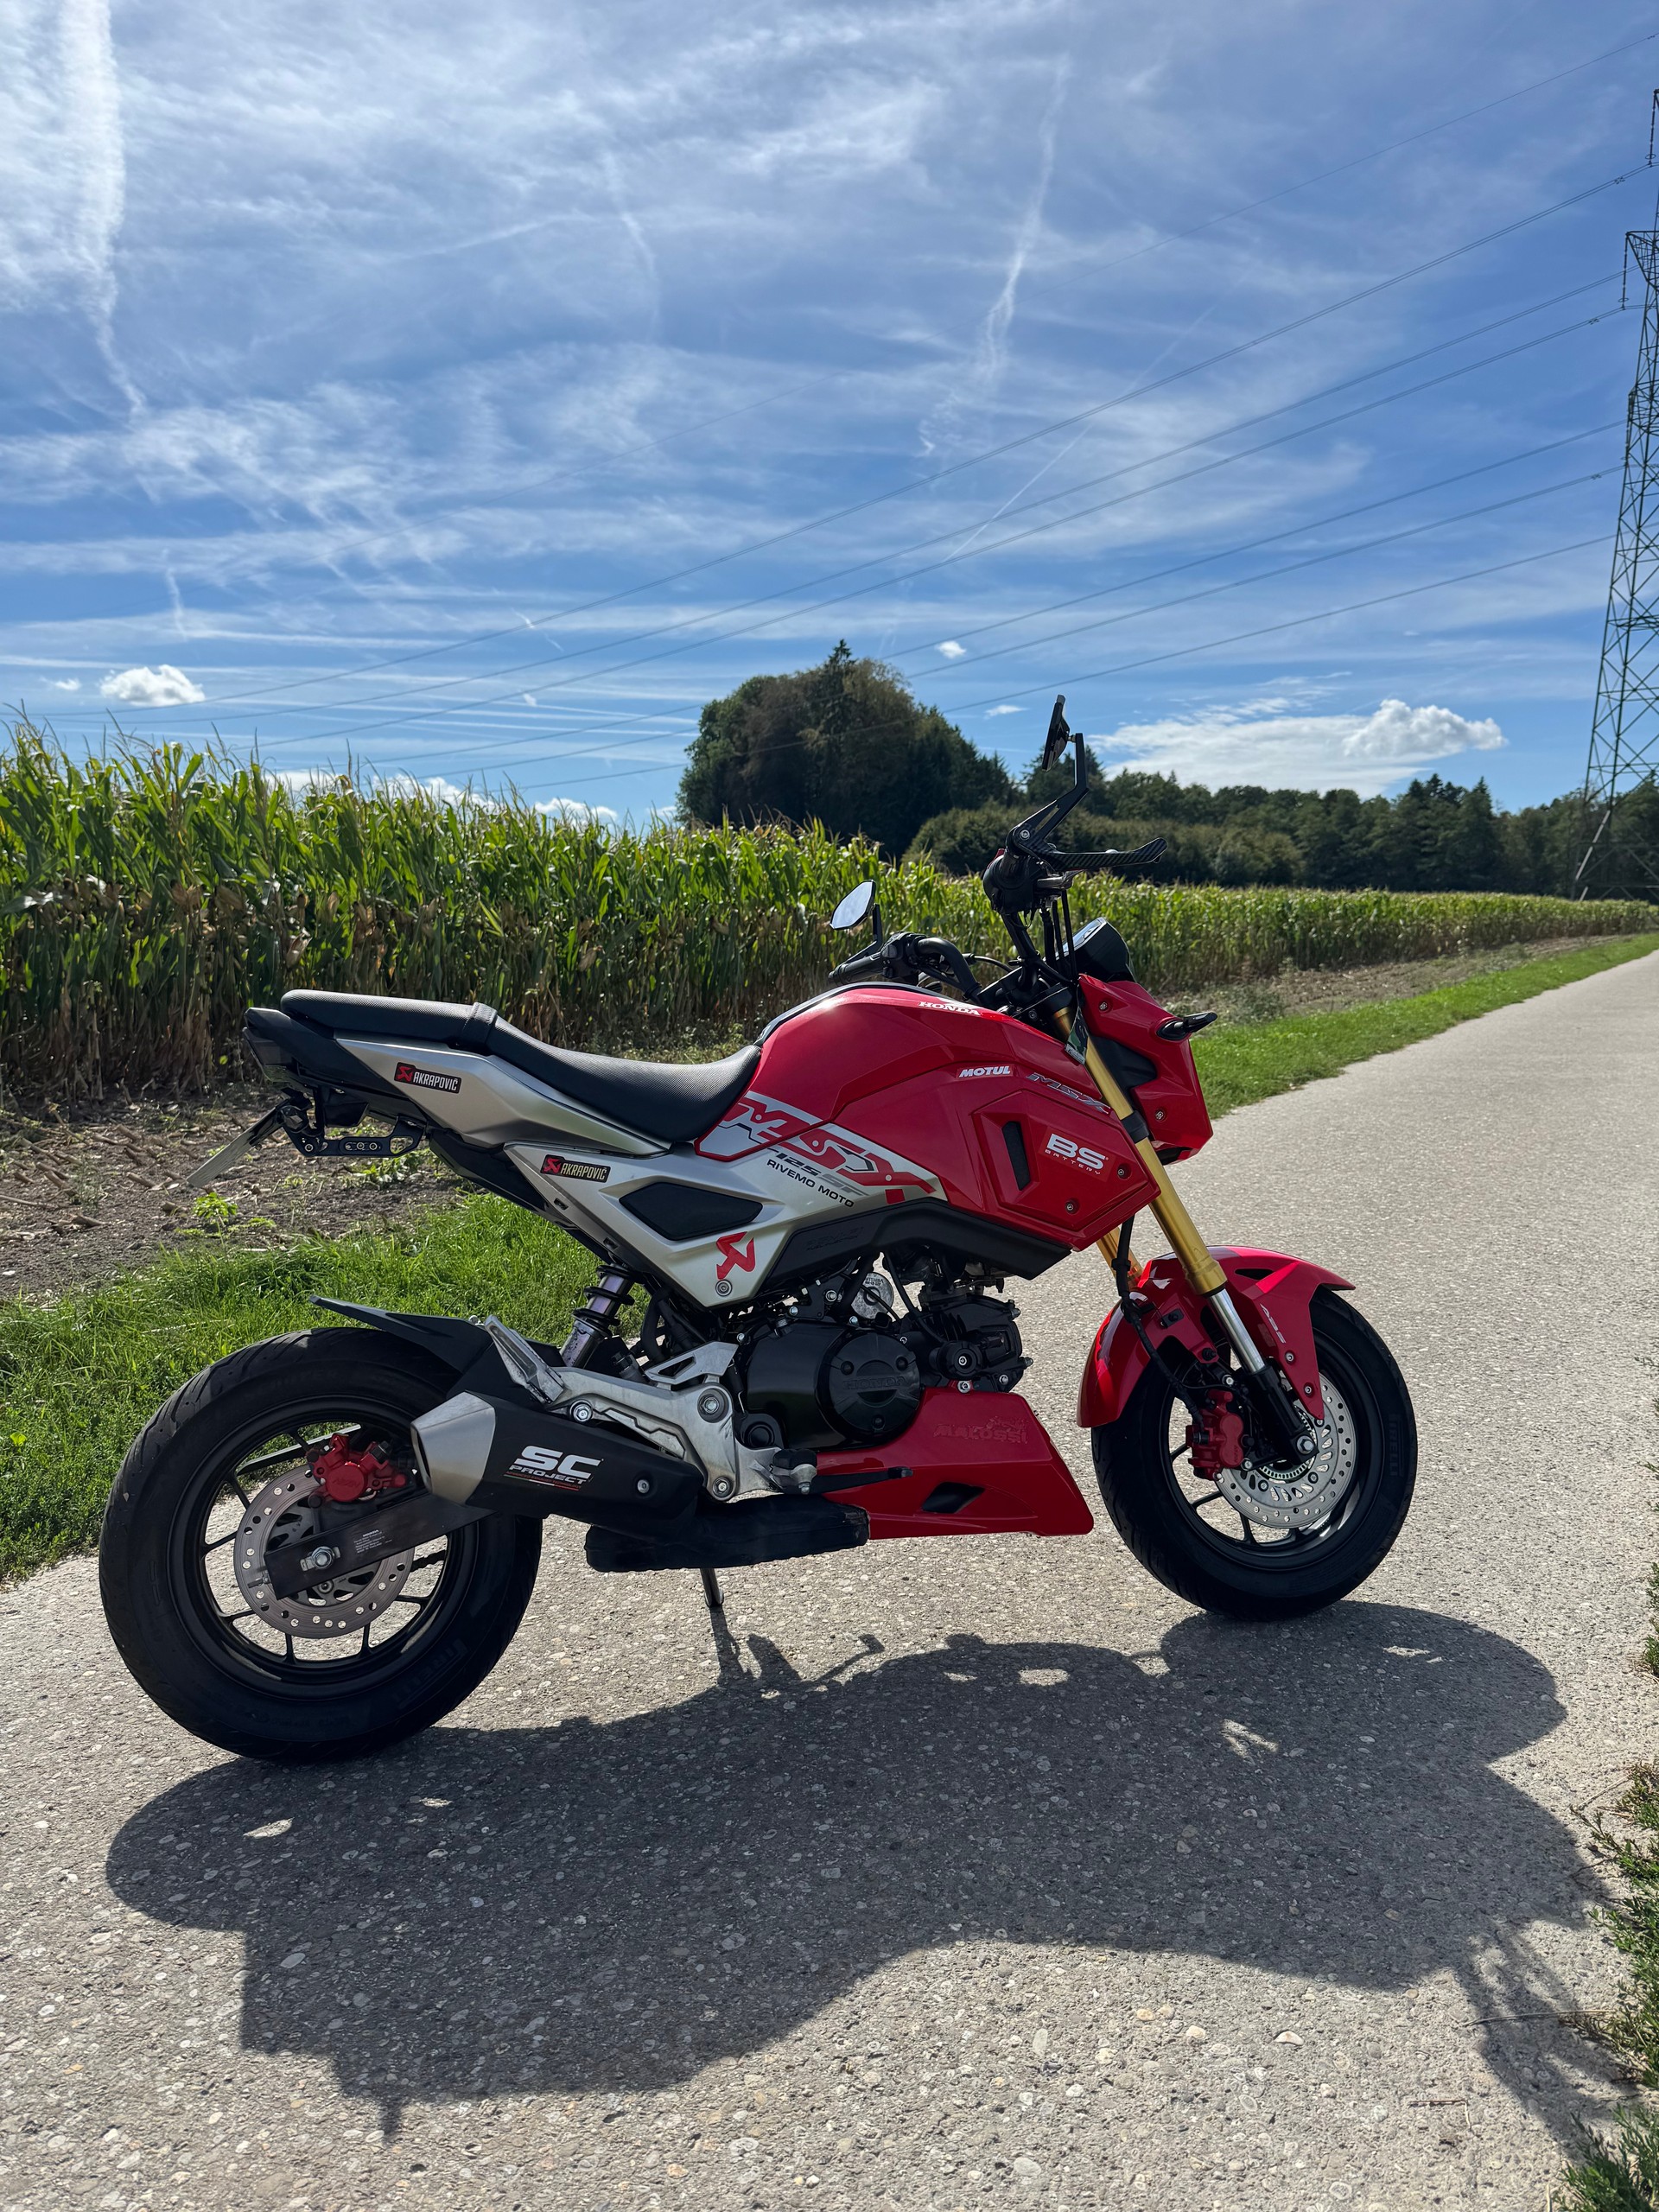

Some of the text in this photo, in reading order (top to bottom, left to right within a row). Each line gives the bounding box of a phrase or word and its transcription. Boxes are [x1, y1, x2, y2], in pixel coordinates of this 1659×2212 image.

[918, 1001, 981, 1015] HONDA
[413, 1071, 458, 1091] AKRAPOVIČ
[959, 1065, 1010, 1077] MOTUL
[1026, 1072, 1111, 1114] MSX
[1045, 1148, 1102, 1175] BATTERY
[1046, 1133, 1106, 1170] BS
[561, 1162, 607, 1181] AKRAPOVIČ
[766, 1159, 855, 1208] RIVEMO MOTO
[1259, 1302, 1287, 1344] ABS
[842, 1376, 908, 1390] HONDA
[932, 1423, 1029, 1445] MALOSSI
[513, 1445, 601, 1479] SC
[509, 1465, 587, 1484] PROJECT
